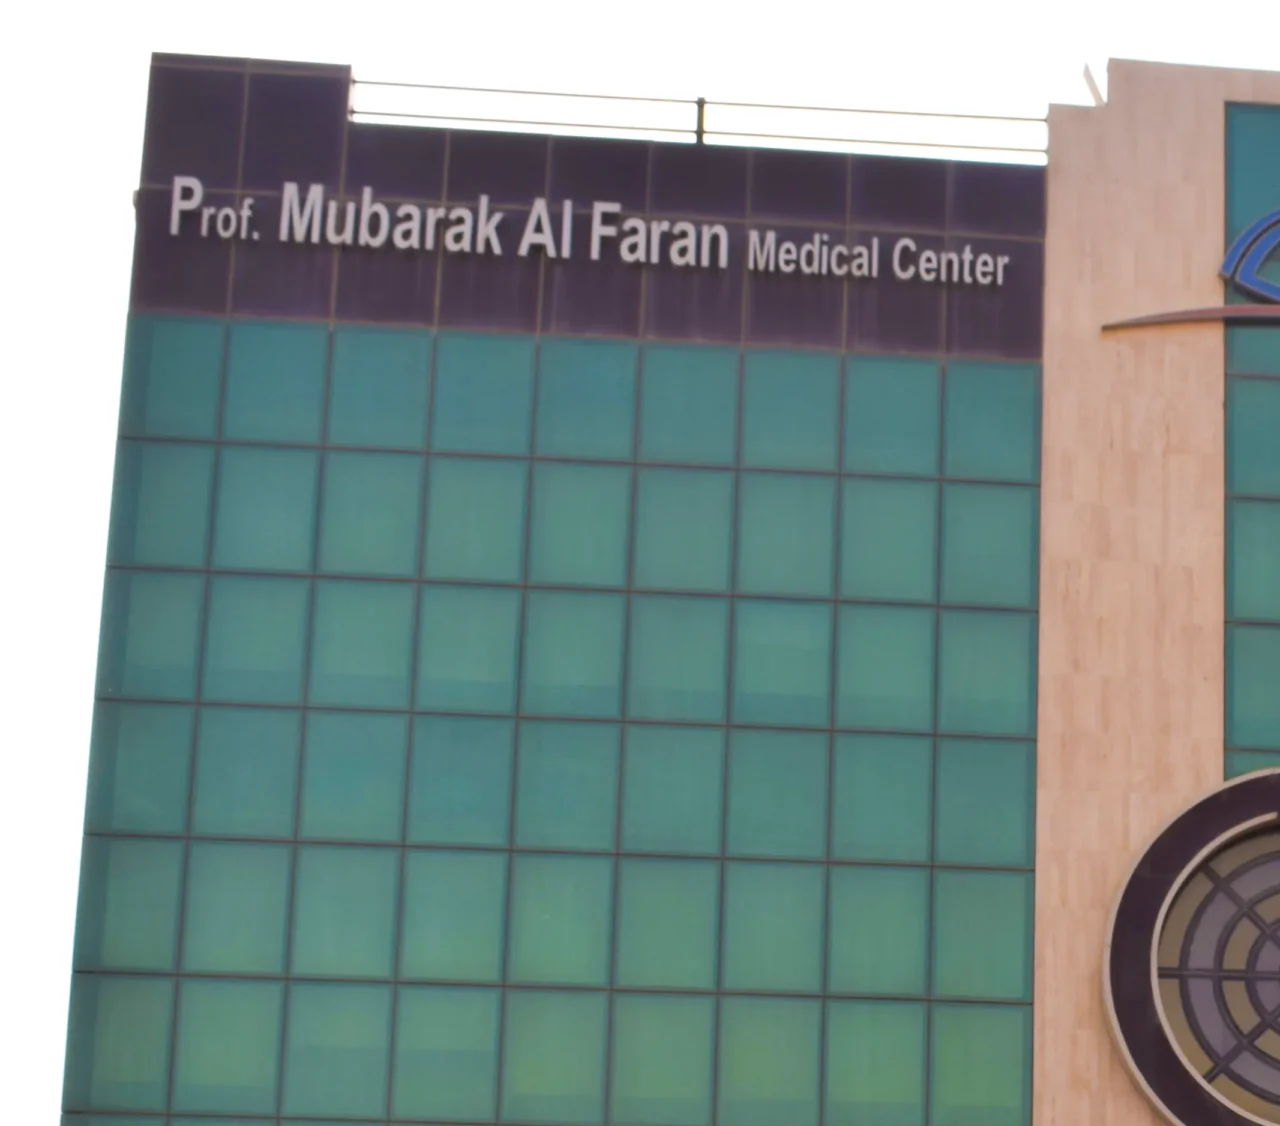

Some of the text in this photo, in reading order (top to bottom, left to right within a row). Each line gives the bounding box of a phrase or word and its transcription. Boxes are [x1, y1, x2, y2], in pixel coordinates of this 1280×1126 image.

[169, 175, 1010, 286] Prof. Mubarak Al Faran Medical Center
